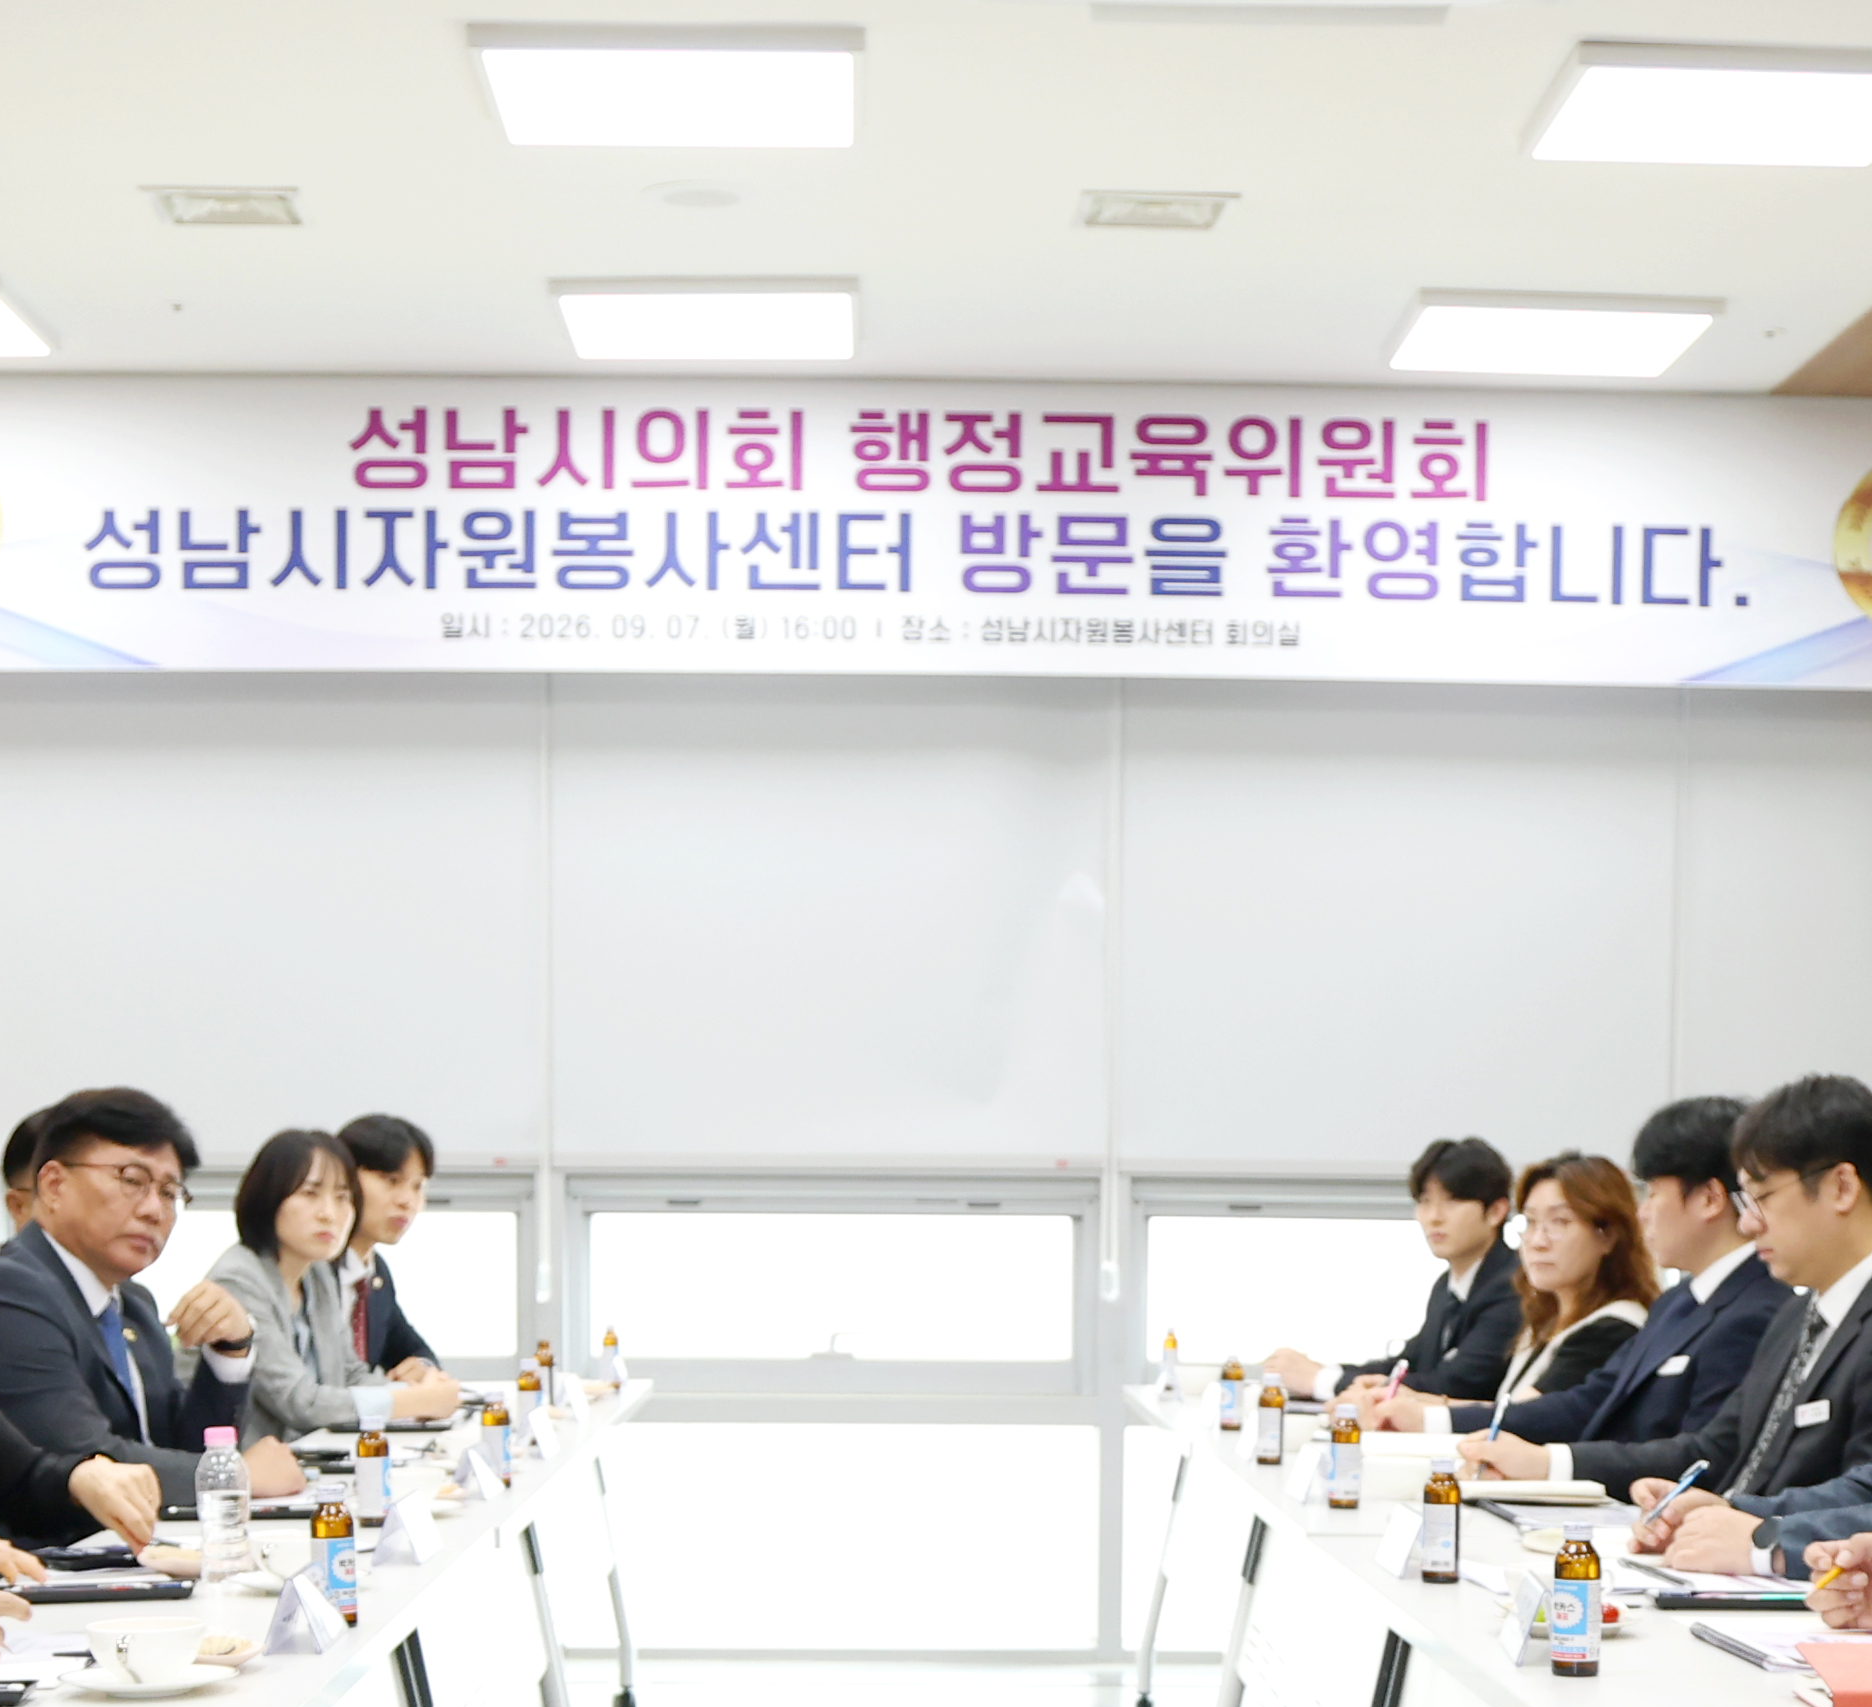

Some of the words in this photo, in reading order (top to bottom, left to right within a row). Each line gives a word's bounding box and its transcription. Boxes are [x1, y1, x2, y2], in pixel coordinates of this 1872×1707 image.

[349, 405, 803, 490] 성남시의회
[850, 410, 1488, 499] 행정교육위원회
[85, 507, 911, 592] 성남시자원봉사센터
[960, 511, 1227, 596] 방문을
[1266, 514, 1749, 607] 환영합니다.
[442, 614, 489, 639] 일시
[520, 613, 599, 640] 2026.
[612, 614, 654, 639] 09.
[667, 615, 709, 640] 07.
[723, 613, 769, 641] (월)
[783, 616, 856, 641] 16:00
[903, 616, 951, 643] 장소
[982, 618, 1213, 645] 성남시자원봉사센터
[1226, 620, 1299, 647] 회의실
